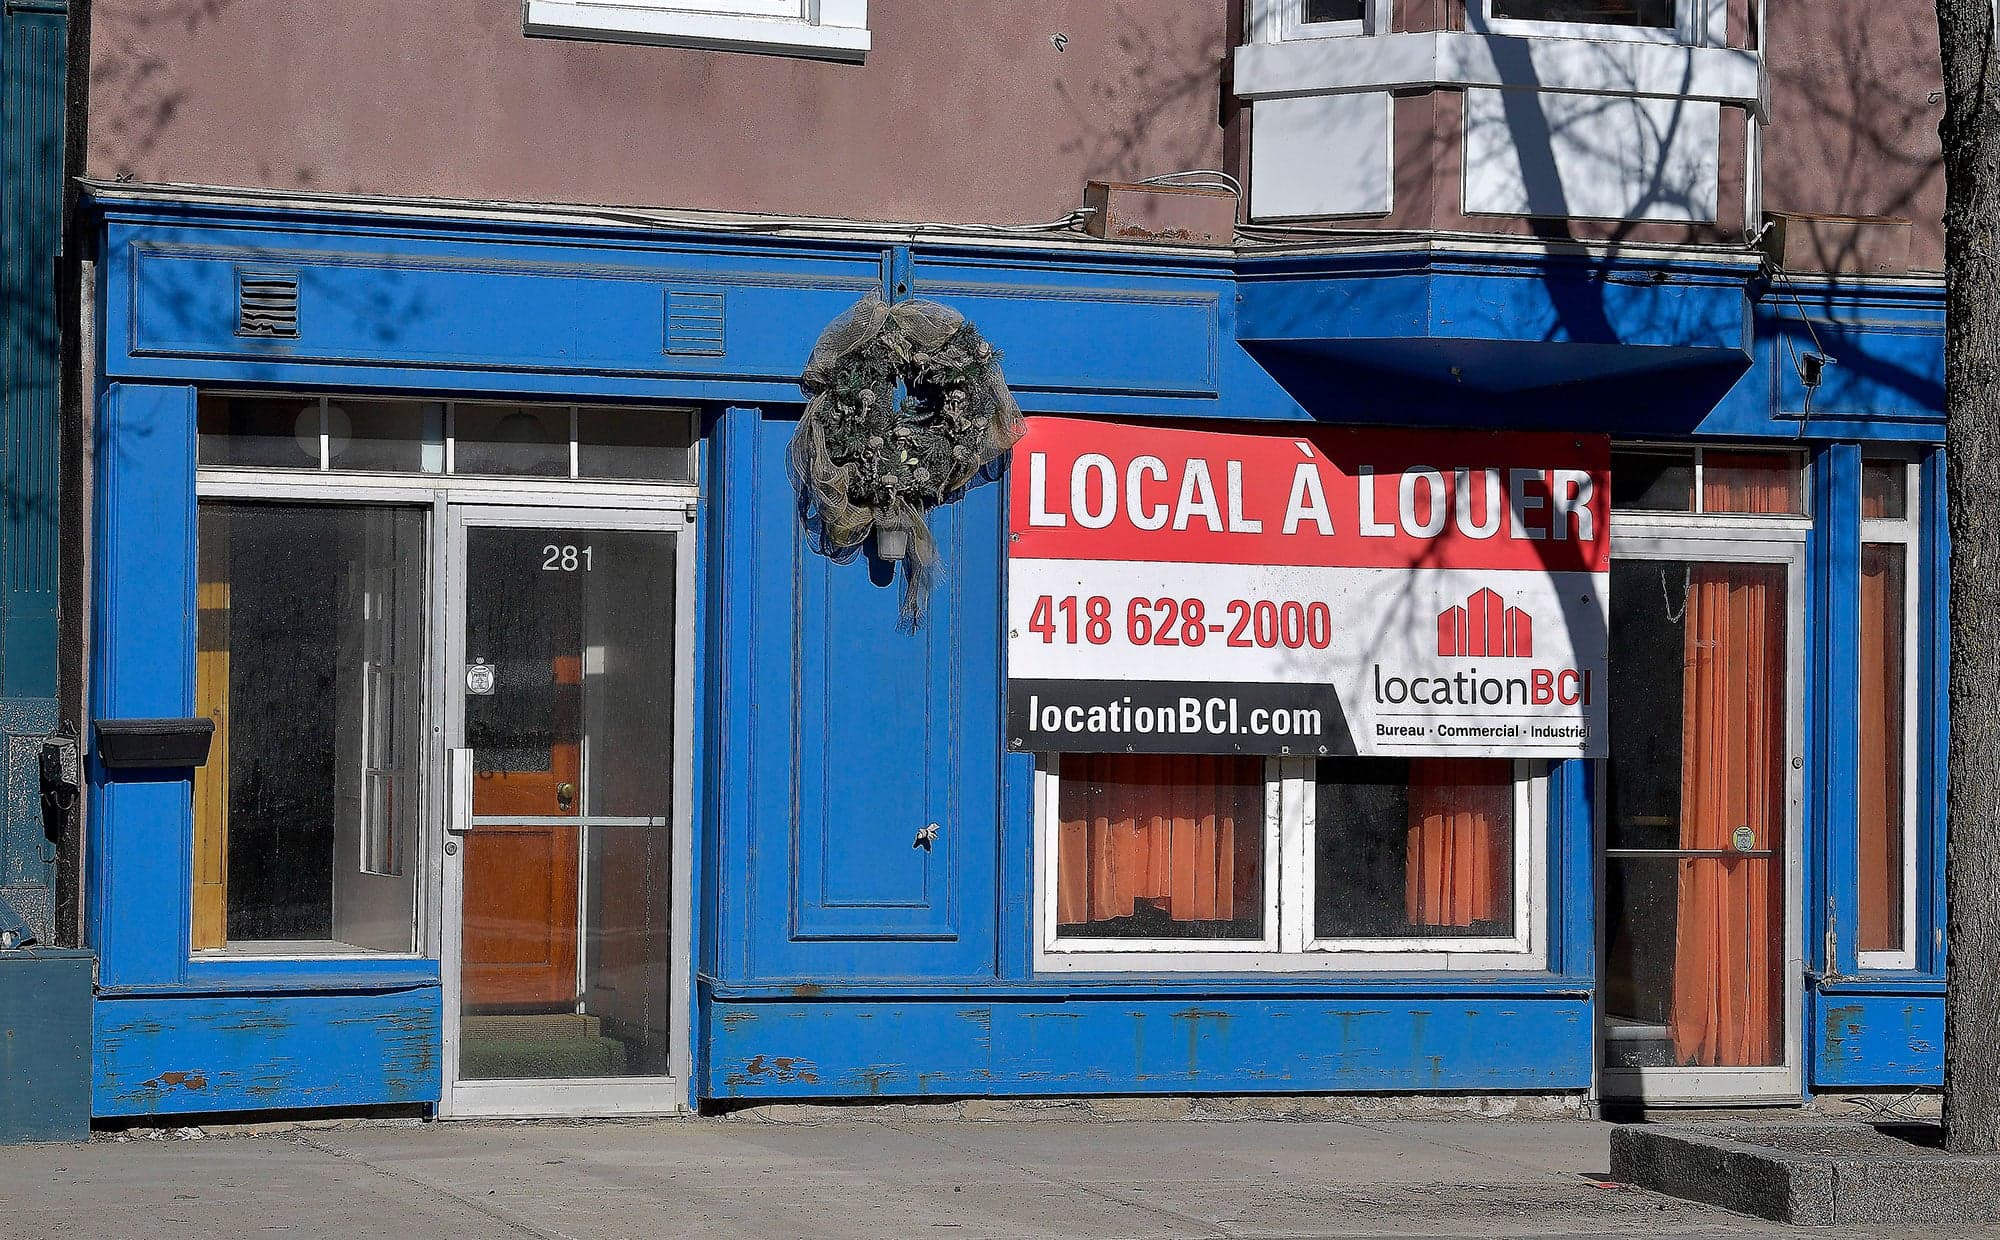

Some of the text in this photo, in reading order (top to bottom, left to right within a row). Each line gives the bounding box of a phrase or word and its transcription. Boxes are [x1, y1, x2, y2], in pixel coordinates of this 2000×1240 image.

[1028, 441, 1595, 541] LOCAL À LOUER
[542, 545, 593, 572] 281
[1028, 595, 1332, 650] 418 628-2000
[1374, 664, 1592, 706] locationBCI
[1028, 695, 1323, 737] locationBCI.com
[1375, 723, 1591, 739] Bureau Commercial Industriel
